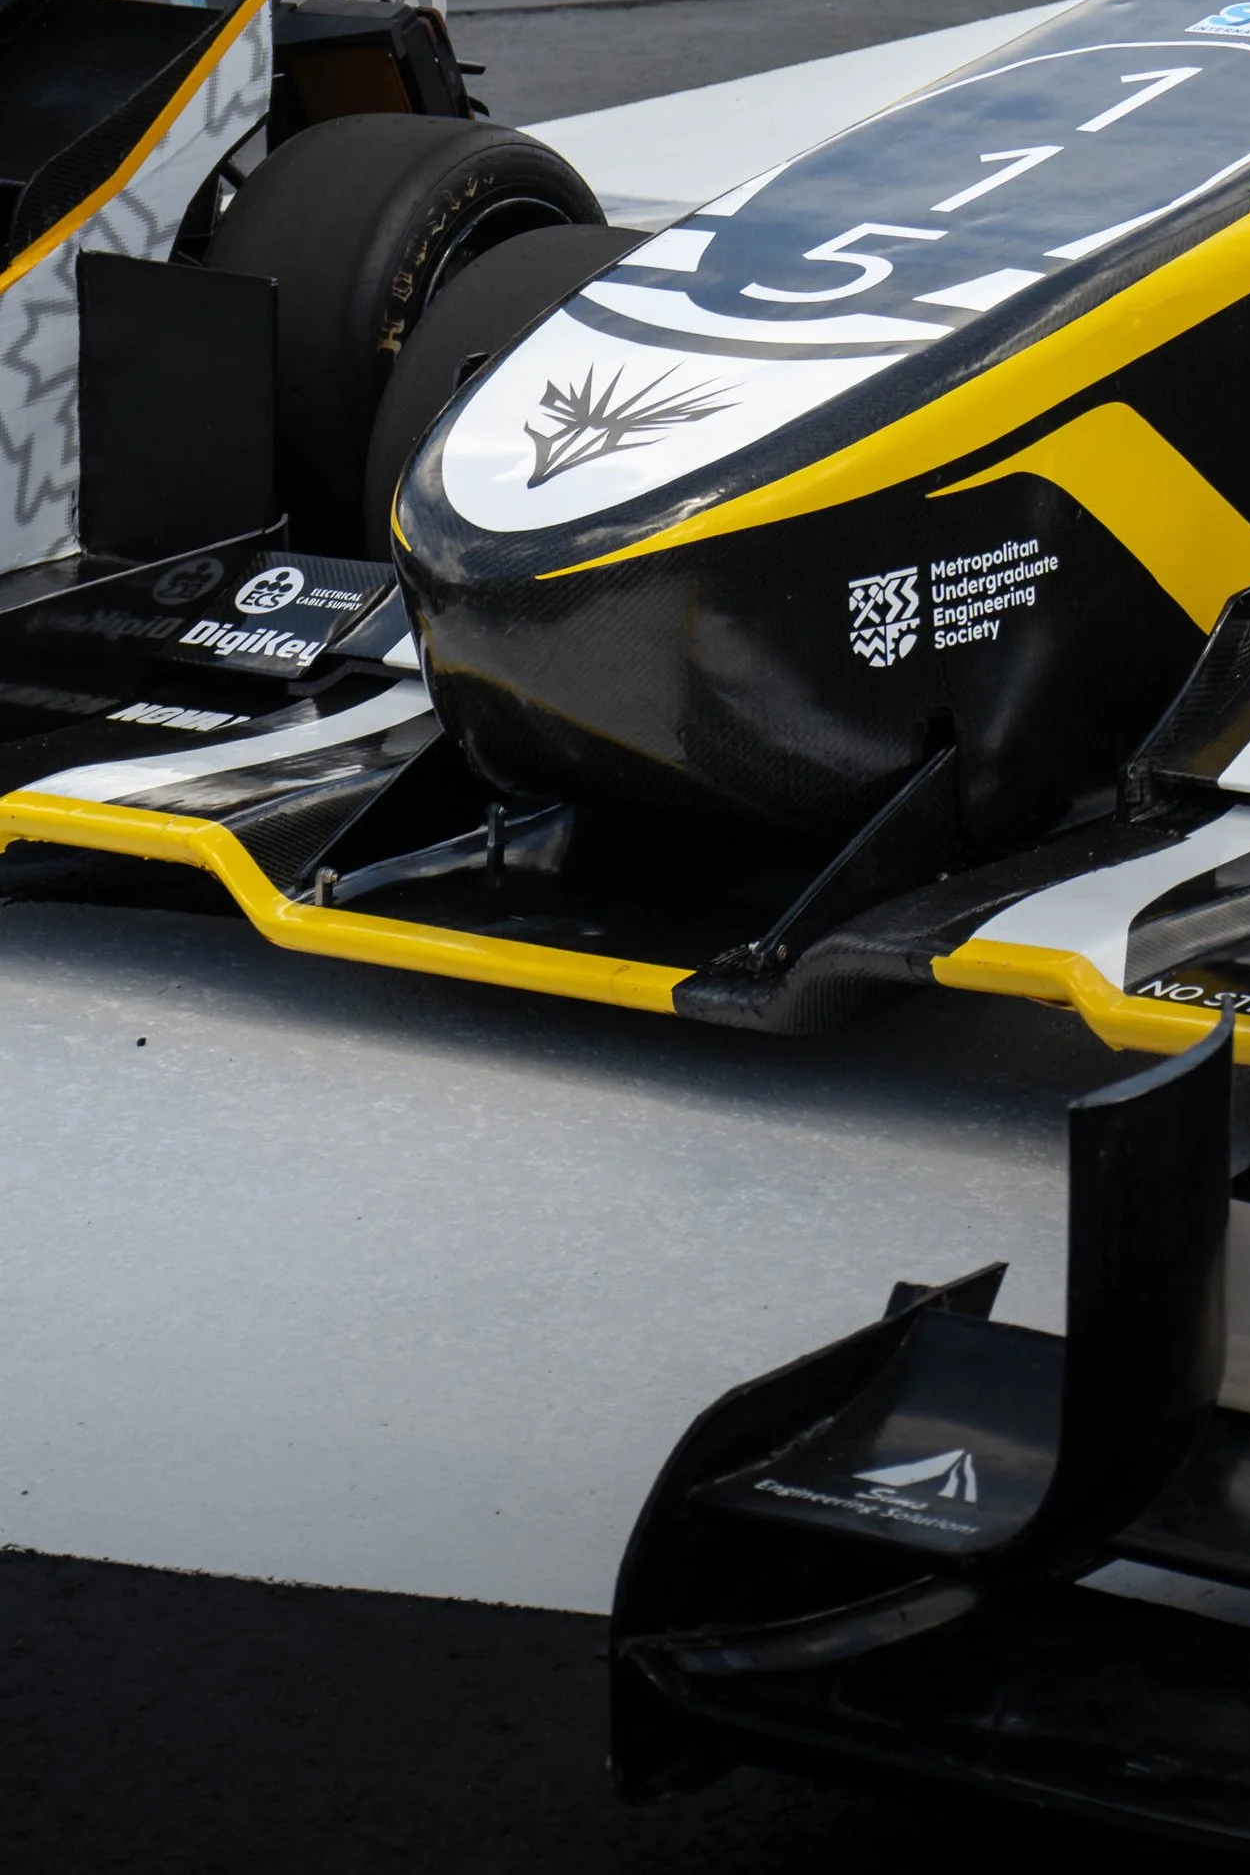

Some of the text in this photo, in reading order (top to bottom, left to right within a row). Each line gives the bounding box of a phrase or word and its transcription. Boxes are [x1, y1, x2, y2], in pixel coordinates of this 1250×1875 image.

[931, 538, 1039, 581] Metropolitan
[309, 588, 363, 602] ELECTRICAL
[932, 555, 1059, 604] Undergraduate
[240, 590, 286, 609] ECS
[295, 596, 363, 612] CABLE SUPPLY
[933, 585, 1036, 628] Engineering
[179, 620, 328, 667] DigiKey
[934, 619, 1001, 650] Society
[1136, 980, 1204, 1001] NO
